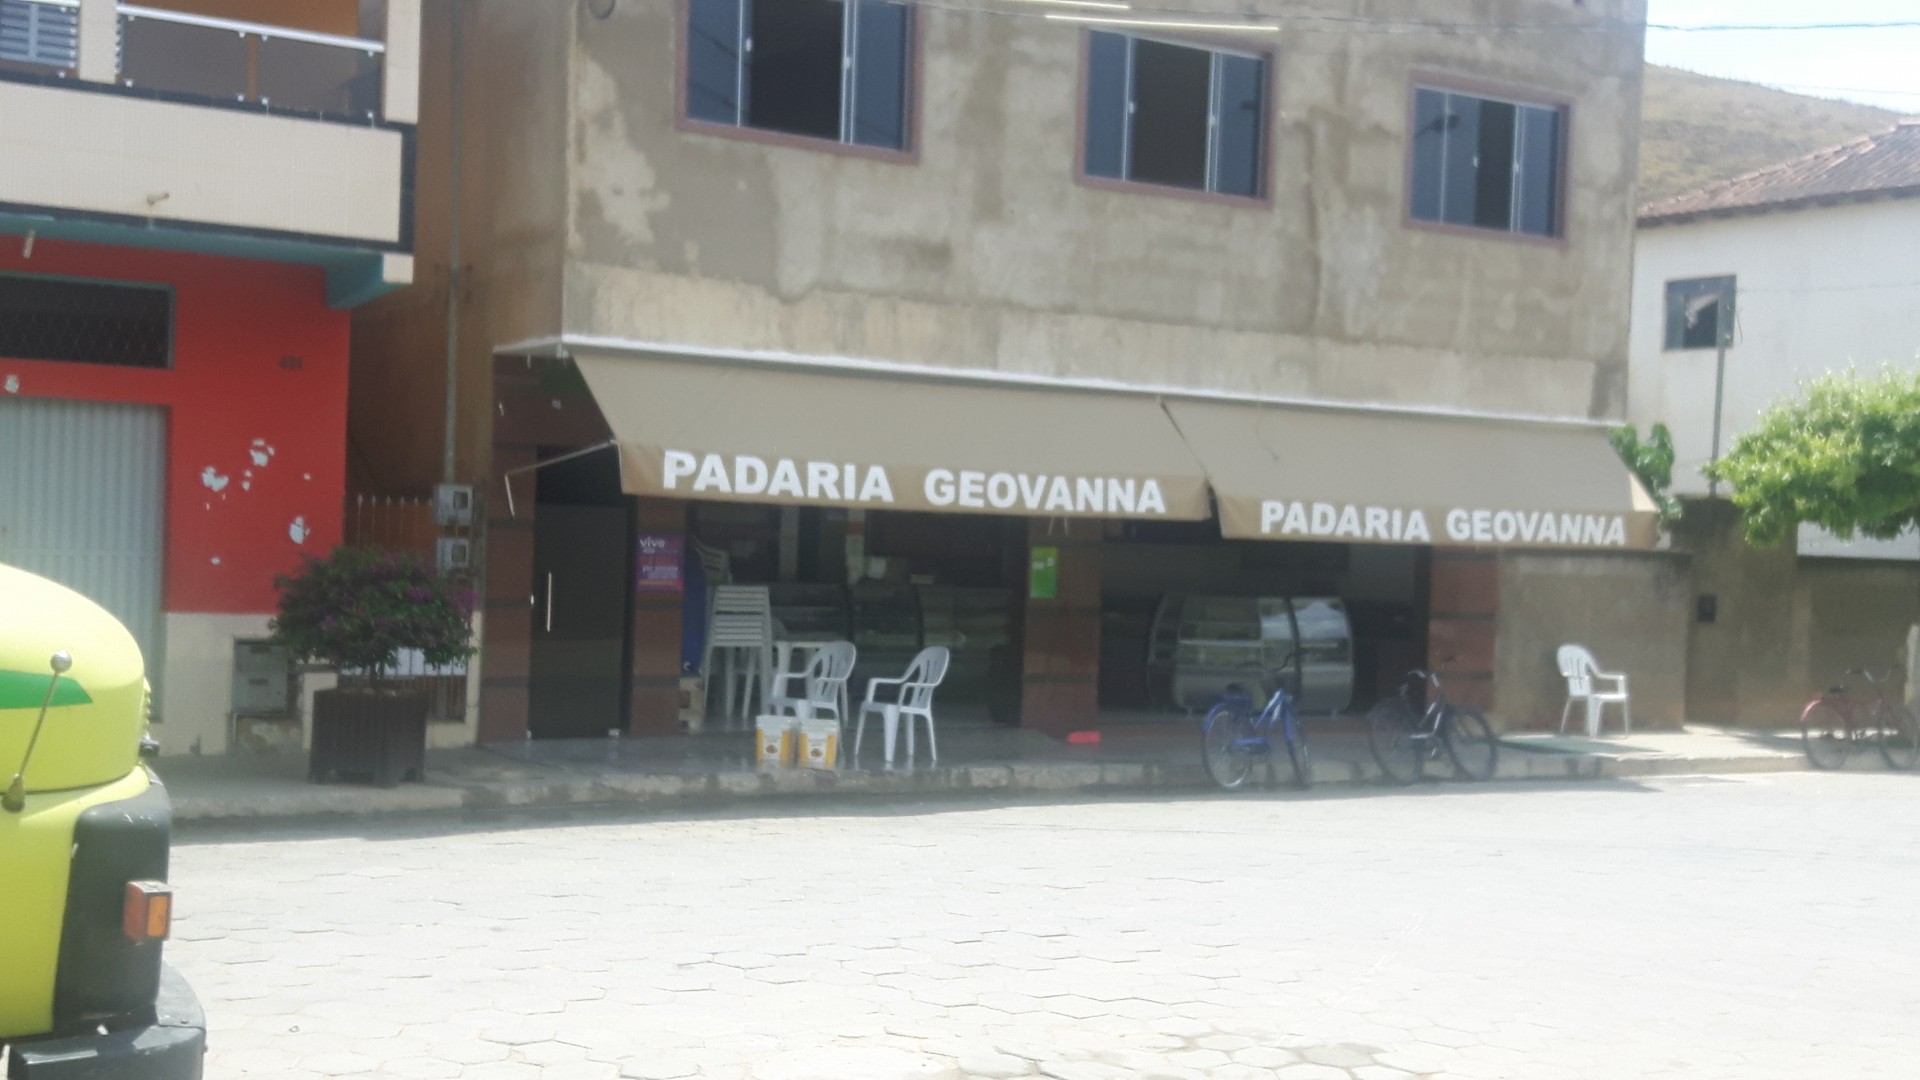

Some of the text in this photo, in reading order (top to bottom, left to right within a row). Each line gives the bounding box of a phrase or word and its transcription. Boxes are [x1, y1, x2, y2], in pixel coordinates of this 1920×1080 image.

[662, 451, 1166, 513] PADARIA GEOVANNA
[639, 535, 666, 548] vivo
[1261, 501, 1626, 545] PADARIA GEOVANNA
